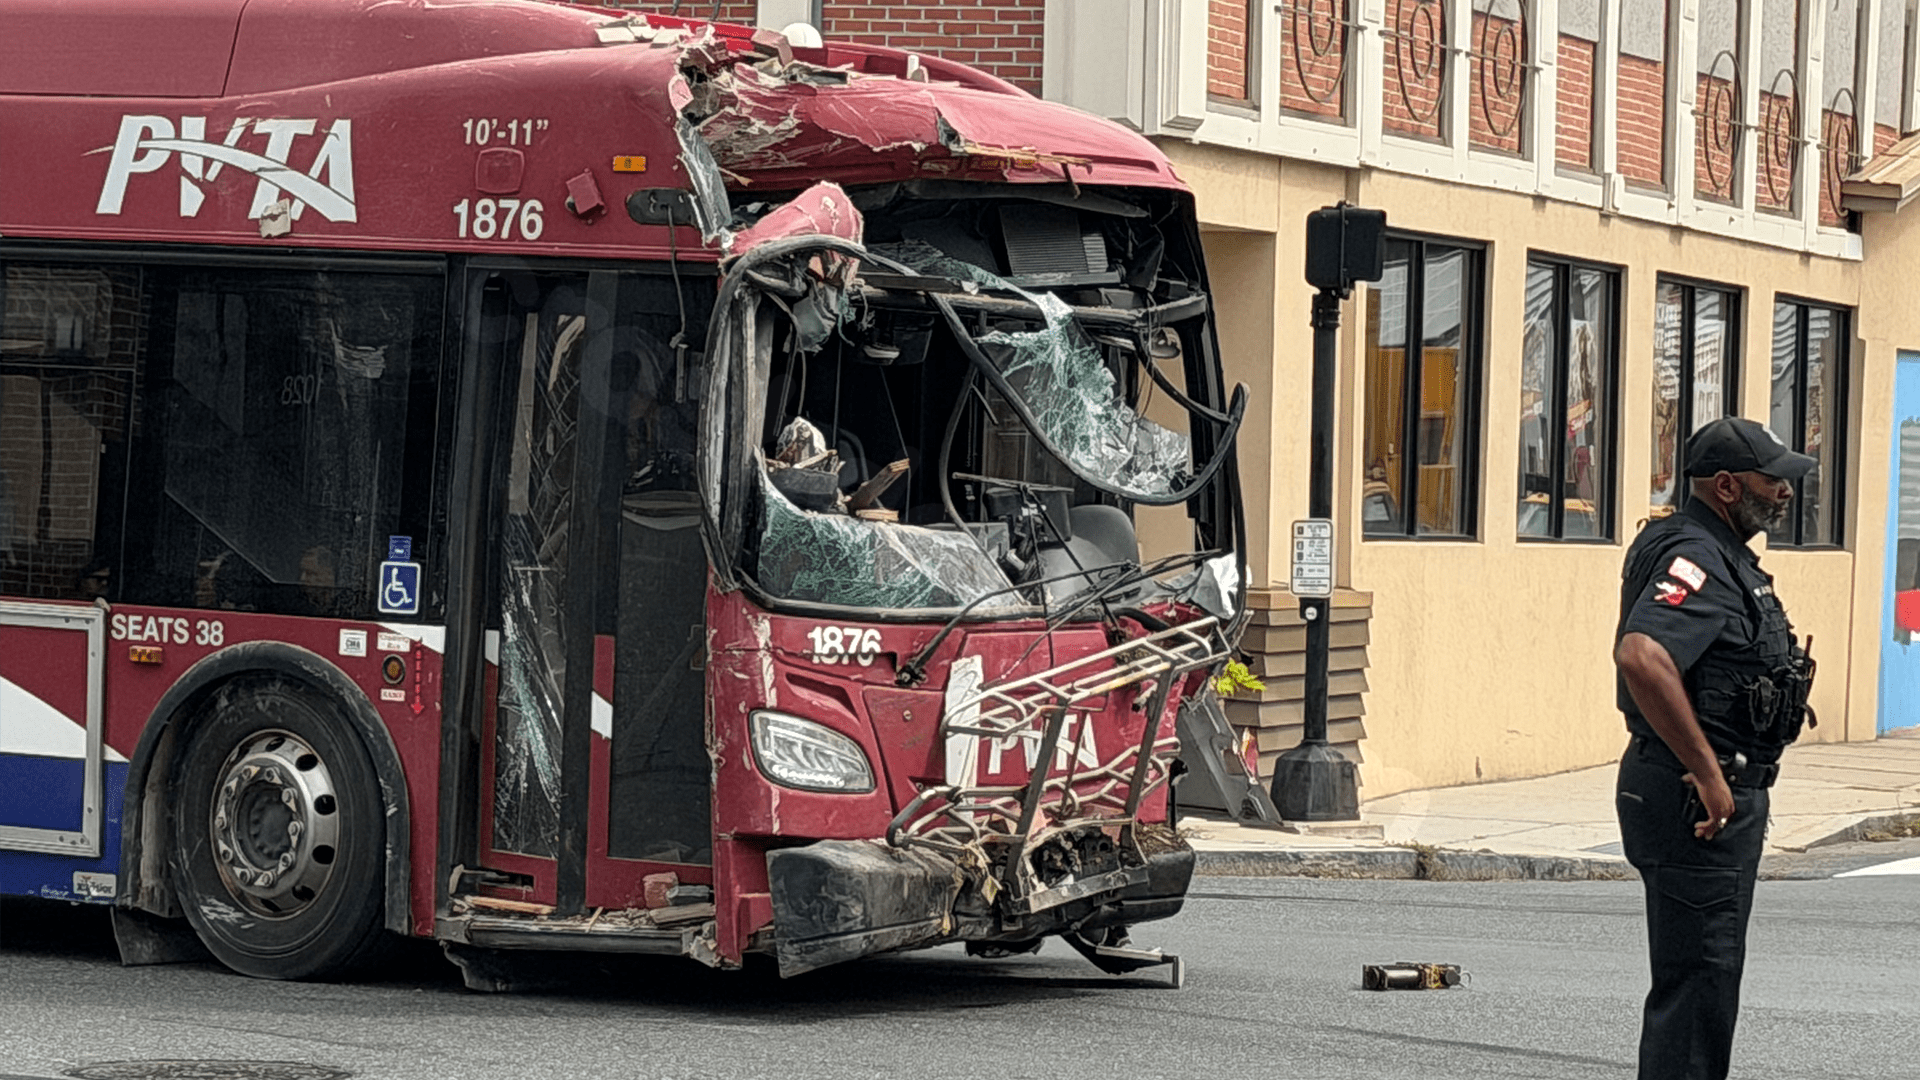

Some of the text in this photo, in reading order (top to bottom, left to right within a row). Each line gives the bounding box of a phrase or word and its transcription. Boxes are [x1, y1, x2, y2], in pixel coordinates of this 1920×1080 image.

[95, 114, 358, 223] PVTA
[453, 198, 543, 240] 1876
[111, 613, 224, 646] SEATS 38
[807, 626, 882, 667] 1876
